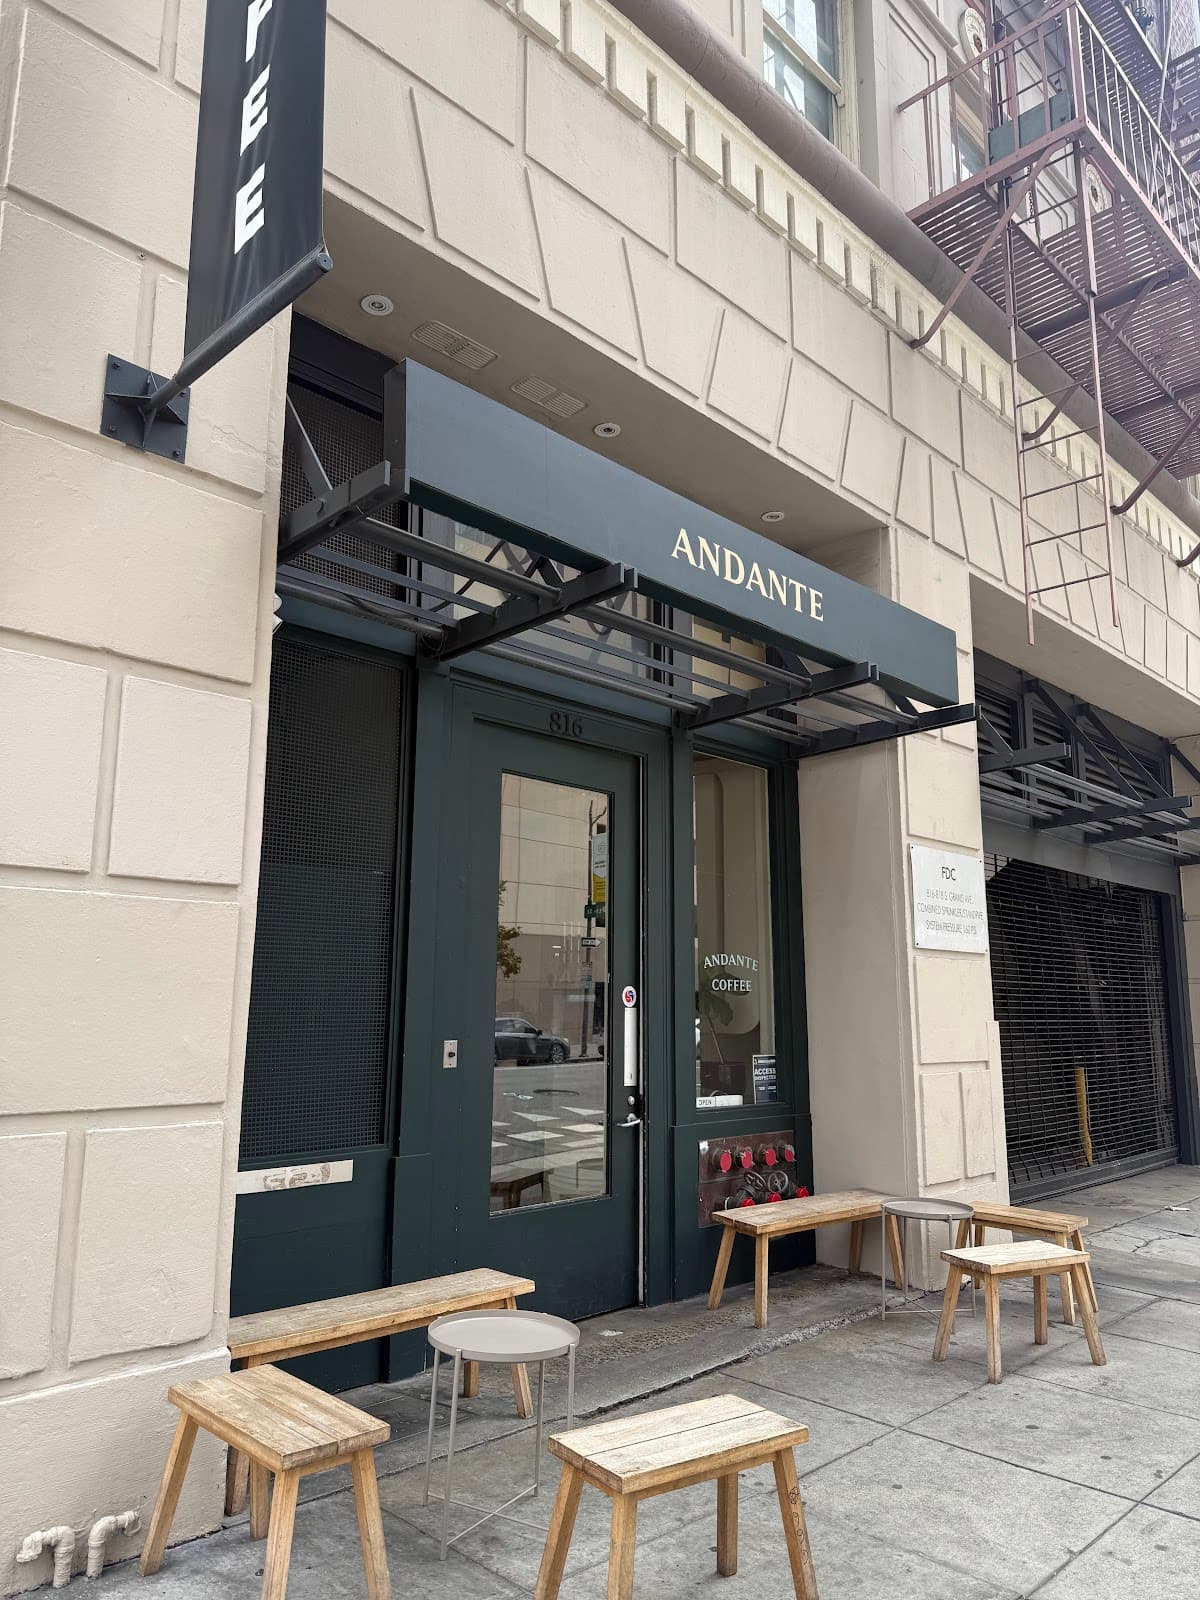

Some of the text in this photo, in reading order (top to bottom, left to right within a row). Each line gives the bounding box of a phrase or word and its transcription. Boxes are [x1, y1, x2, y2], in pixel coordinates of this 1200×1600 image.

[671, 527, 825, 622] ANDANTE
[549, 711, 583, 738] 816
[941, 866, 957, 881] FDC
[917, 902, 941, 915] COMBINED
[703, 953, 759, 972] ANDANTE
[711, 978, 752, 992] COFFEE
[754, 1067, 777, 1075] ACCESS
